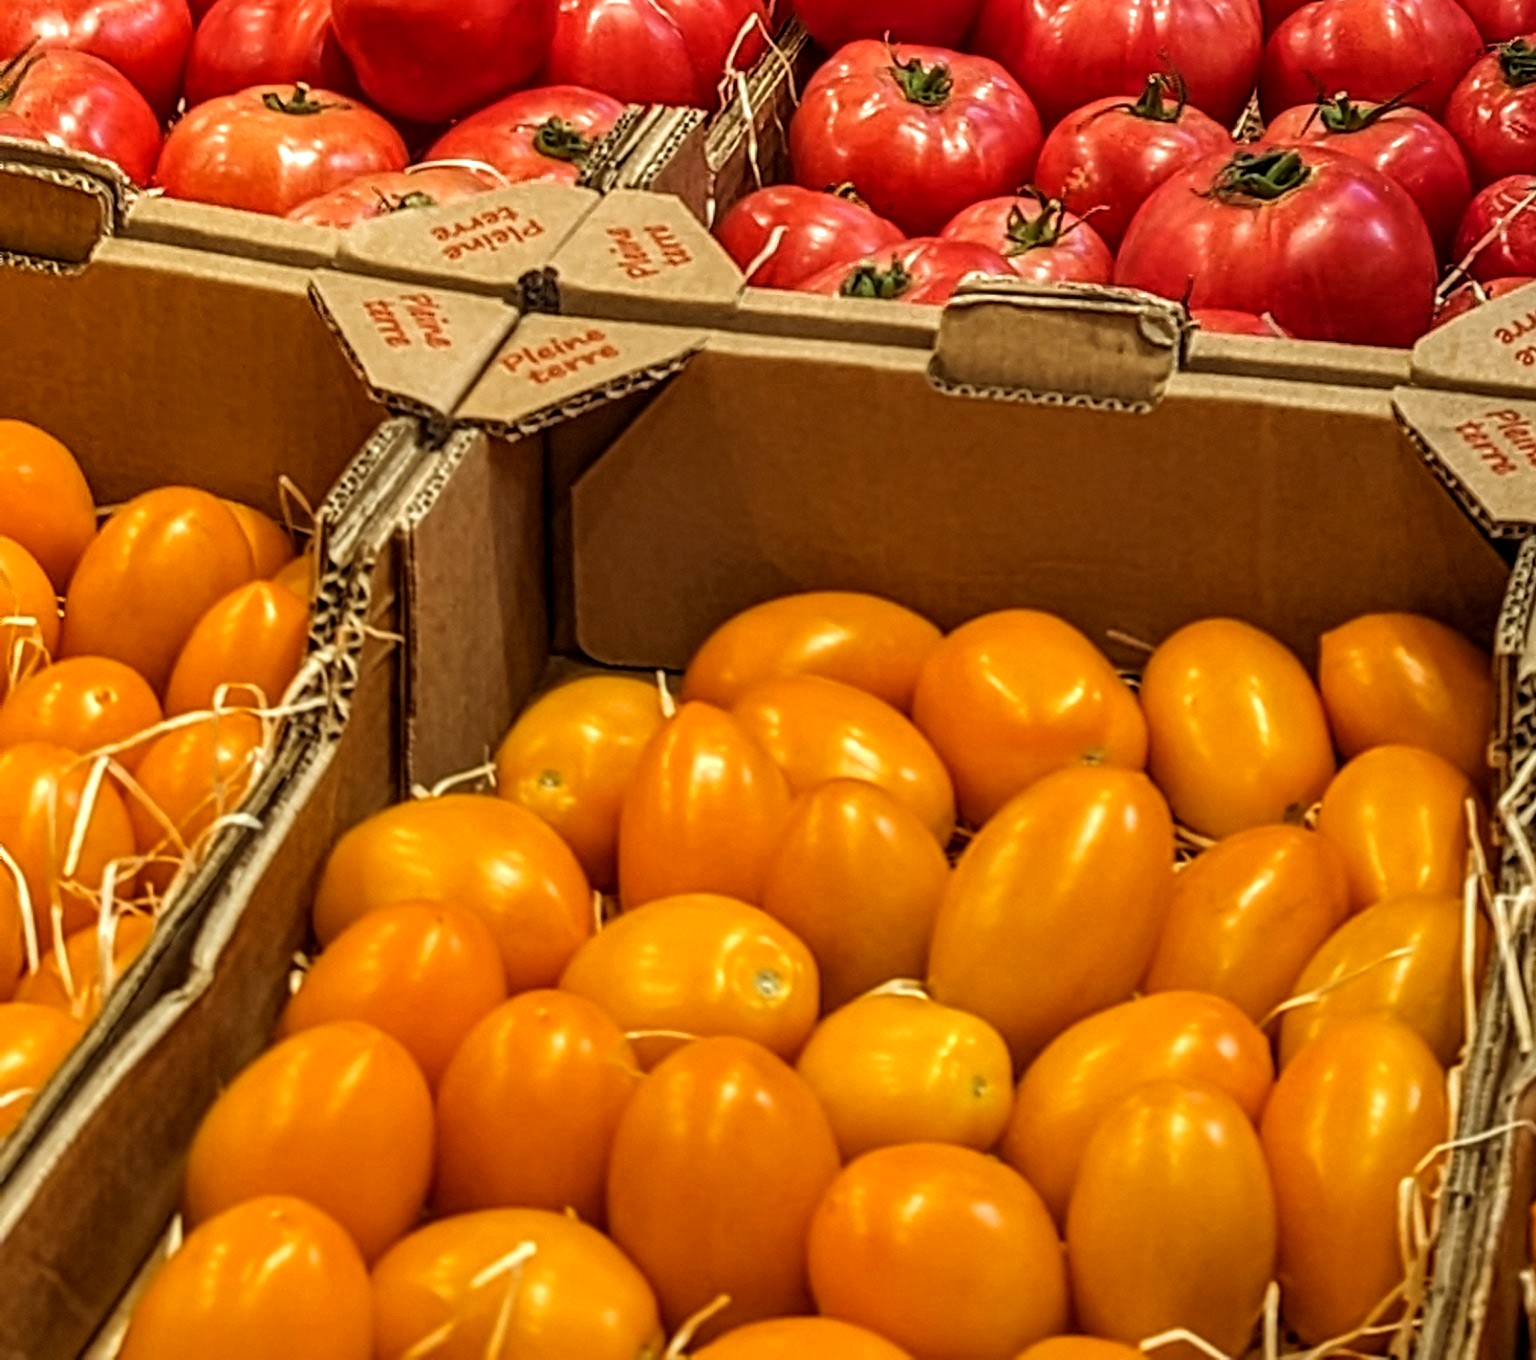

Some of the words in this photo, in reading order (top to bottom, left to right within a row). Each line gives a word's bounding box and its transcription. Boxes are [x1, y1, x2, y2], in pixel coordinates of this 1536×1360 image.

[430, 206, 518, 241] terre
[442, 219, 545, 260] Pleine
[501, 328, 606, 372] Pleine
[528, 343, 620, 386] terre
[1455, 420, 1518, 476] terre
